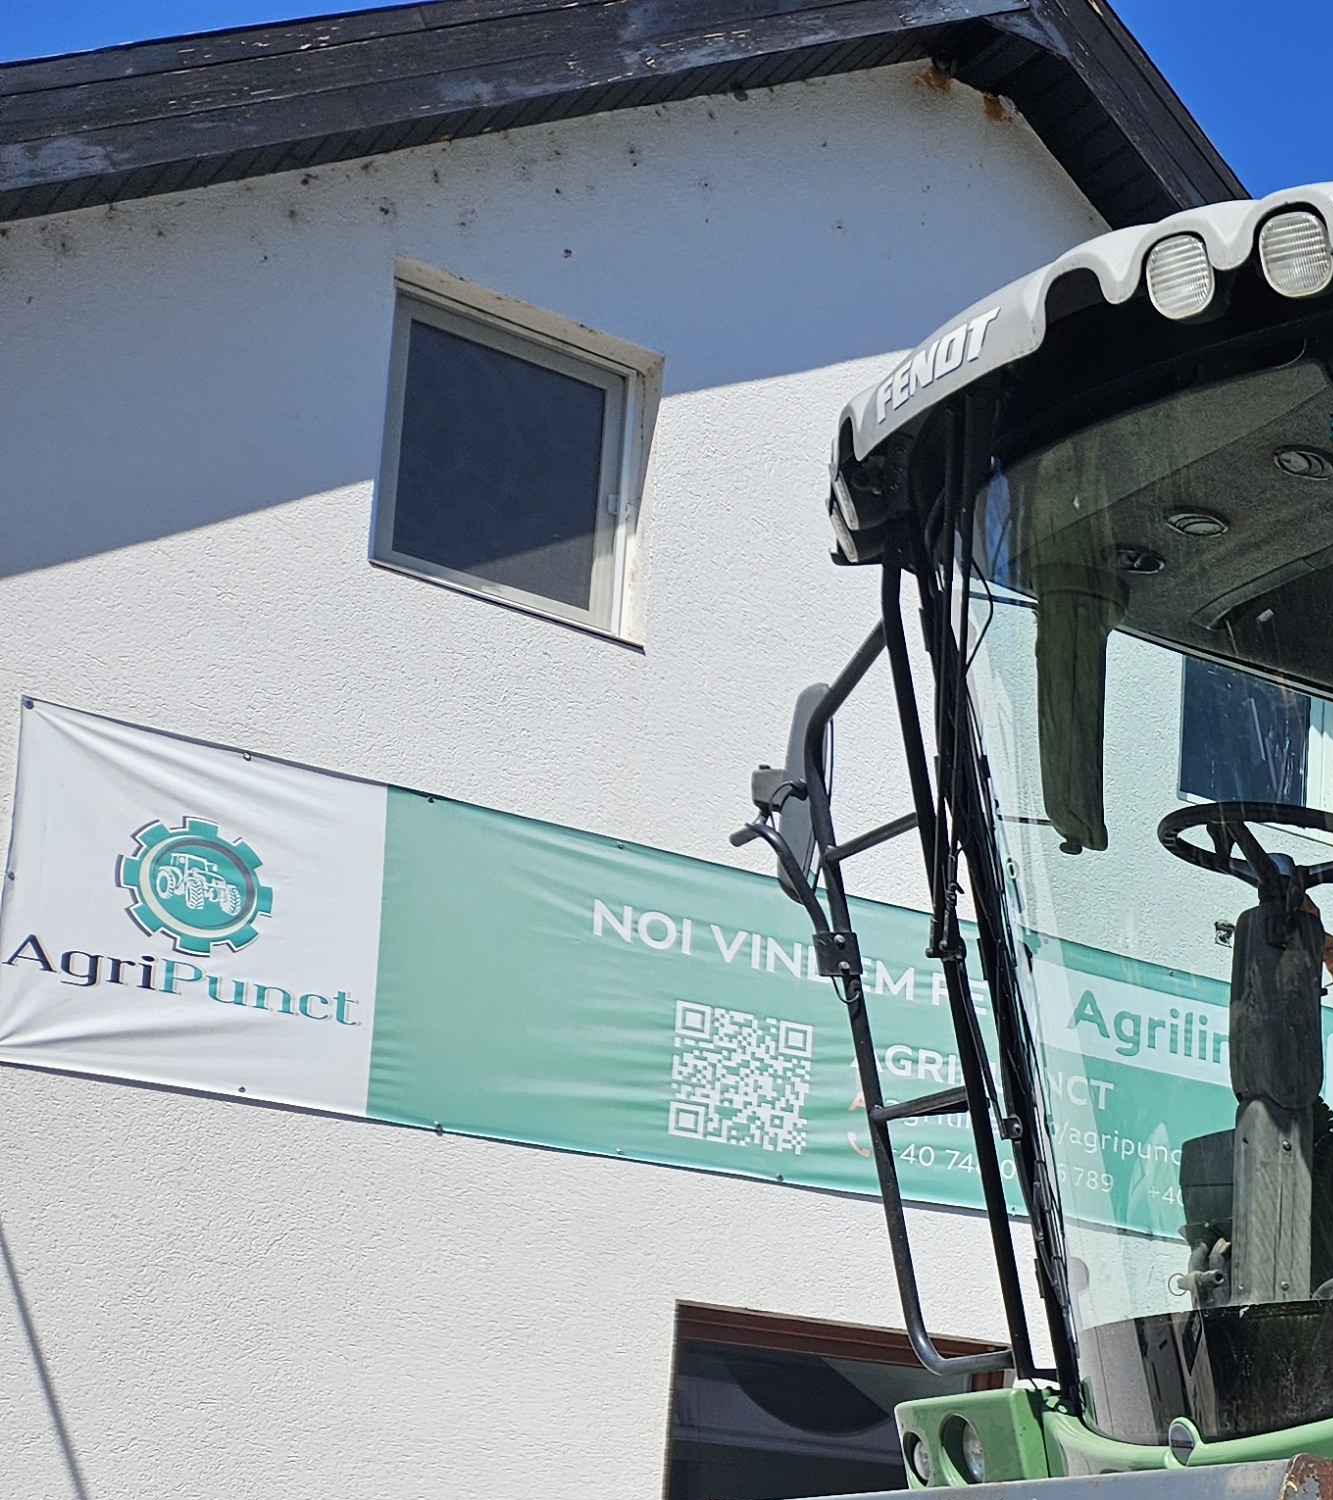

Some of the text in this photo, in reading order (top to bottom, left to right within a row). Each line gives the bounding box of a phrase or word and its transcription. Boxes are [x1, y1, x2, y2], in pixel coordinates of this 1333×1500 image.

[876, 306, 1001, 425] FENDT
[592, 898, 692, 956] NOI
[2, 933, 362, 1026] AgriPunct
[1065, 989, 1229, 1064] Agrilin
